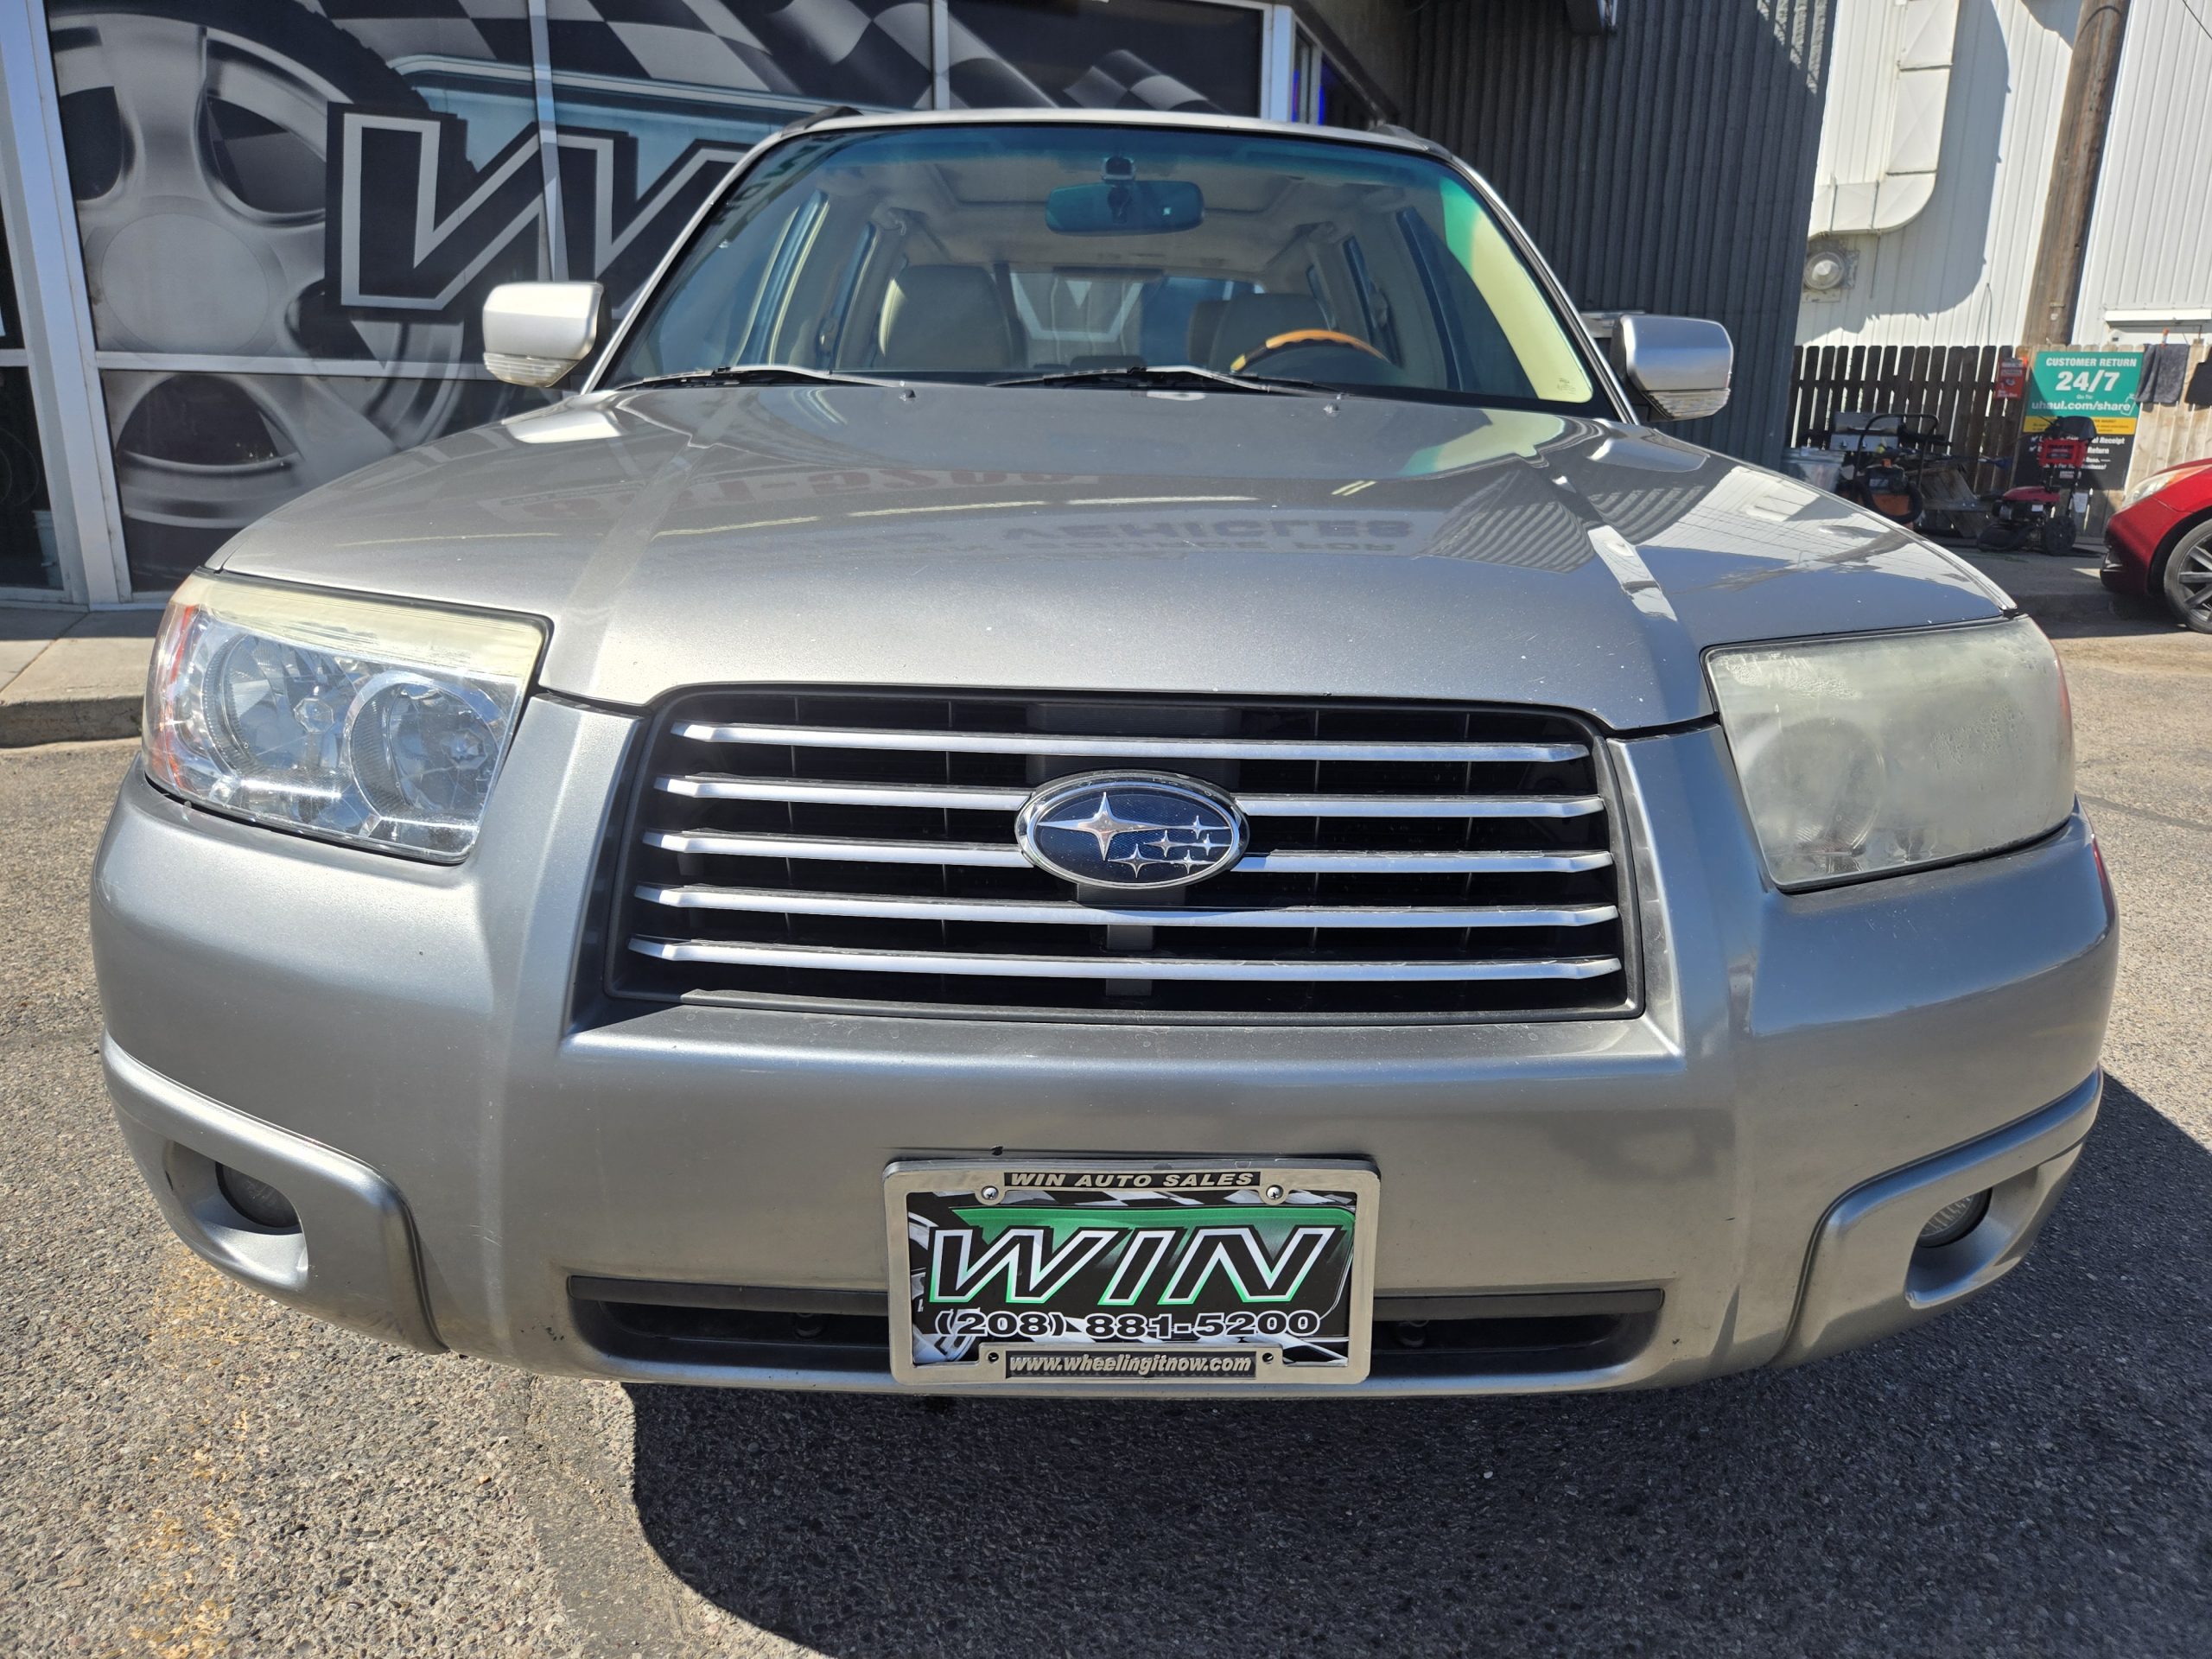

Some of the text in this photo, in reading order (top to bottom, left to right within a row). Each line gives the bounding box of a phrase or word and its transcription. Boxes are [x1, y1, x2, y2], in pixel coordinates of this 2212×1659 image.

[2045, 357, 2138, 367] CUSTOMER RETURN
[2055, 369, 2121, 393] 24/7
[2031, 400, 2132, 412] uhaul.com/share
[1010, 1172, 1254, 1187] WIN AUTO SALES
[930, 1226, 1336, 1306] WIN
[935, 1310, 1321, 1338] (208) 881-5200
[1009, 1354, 1252, 1376] www.wheelingitnow.com
